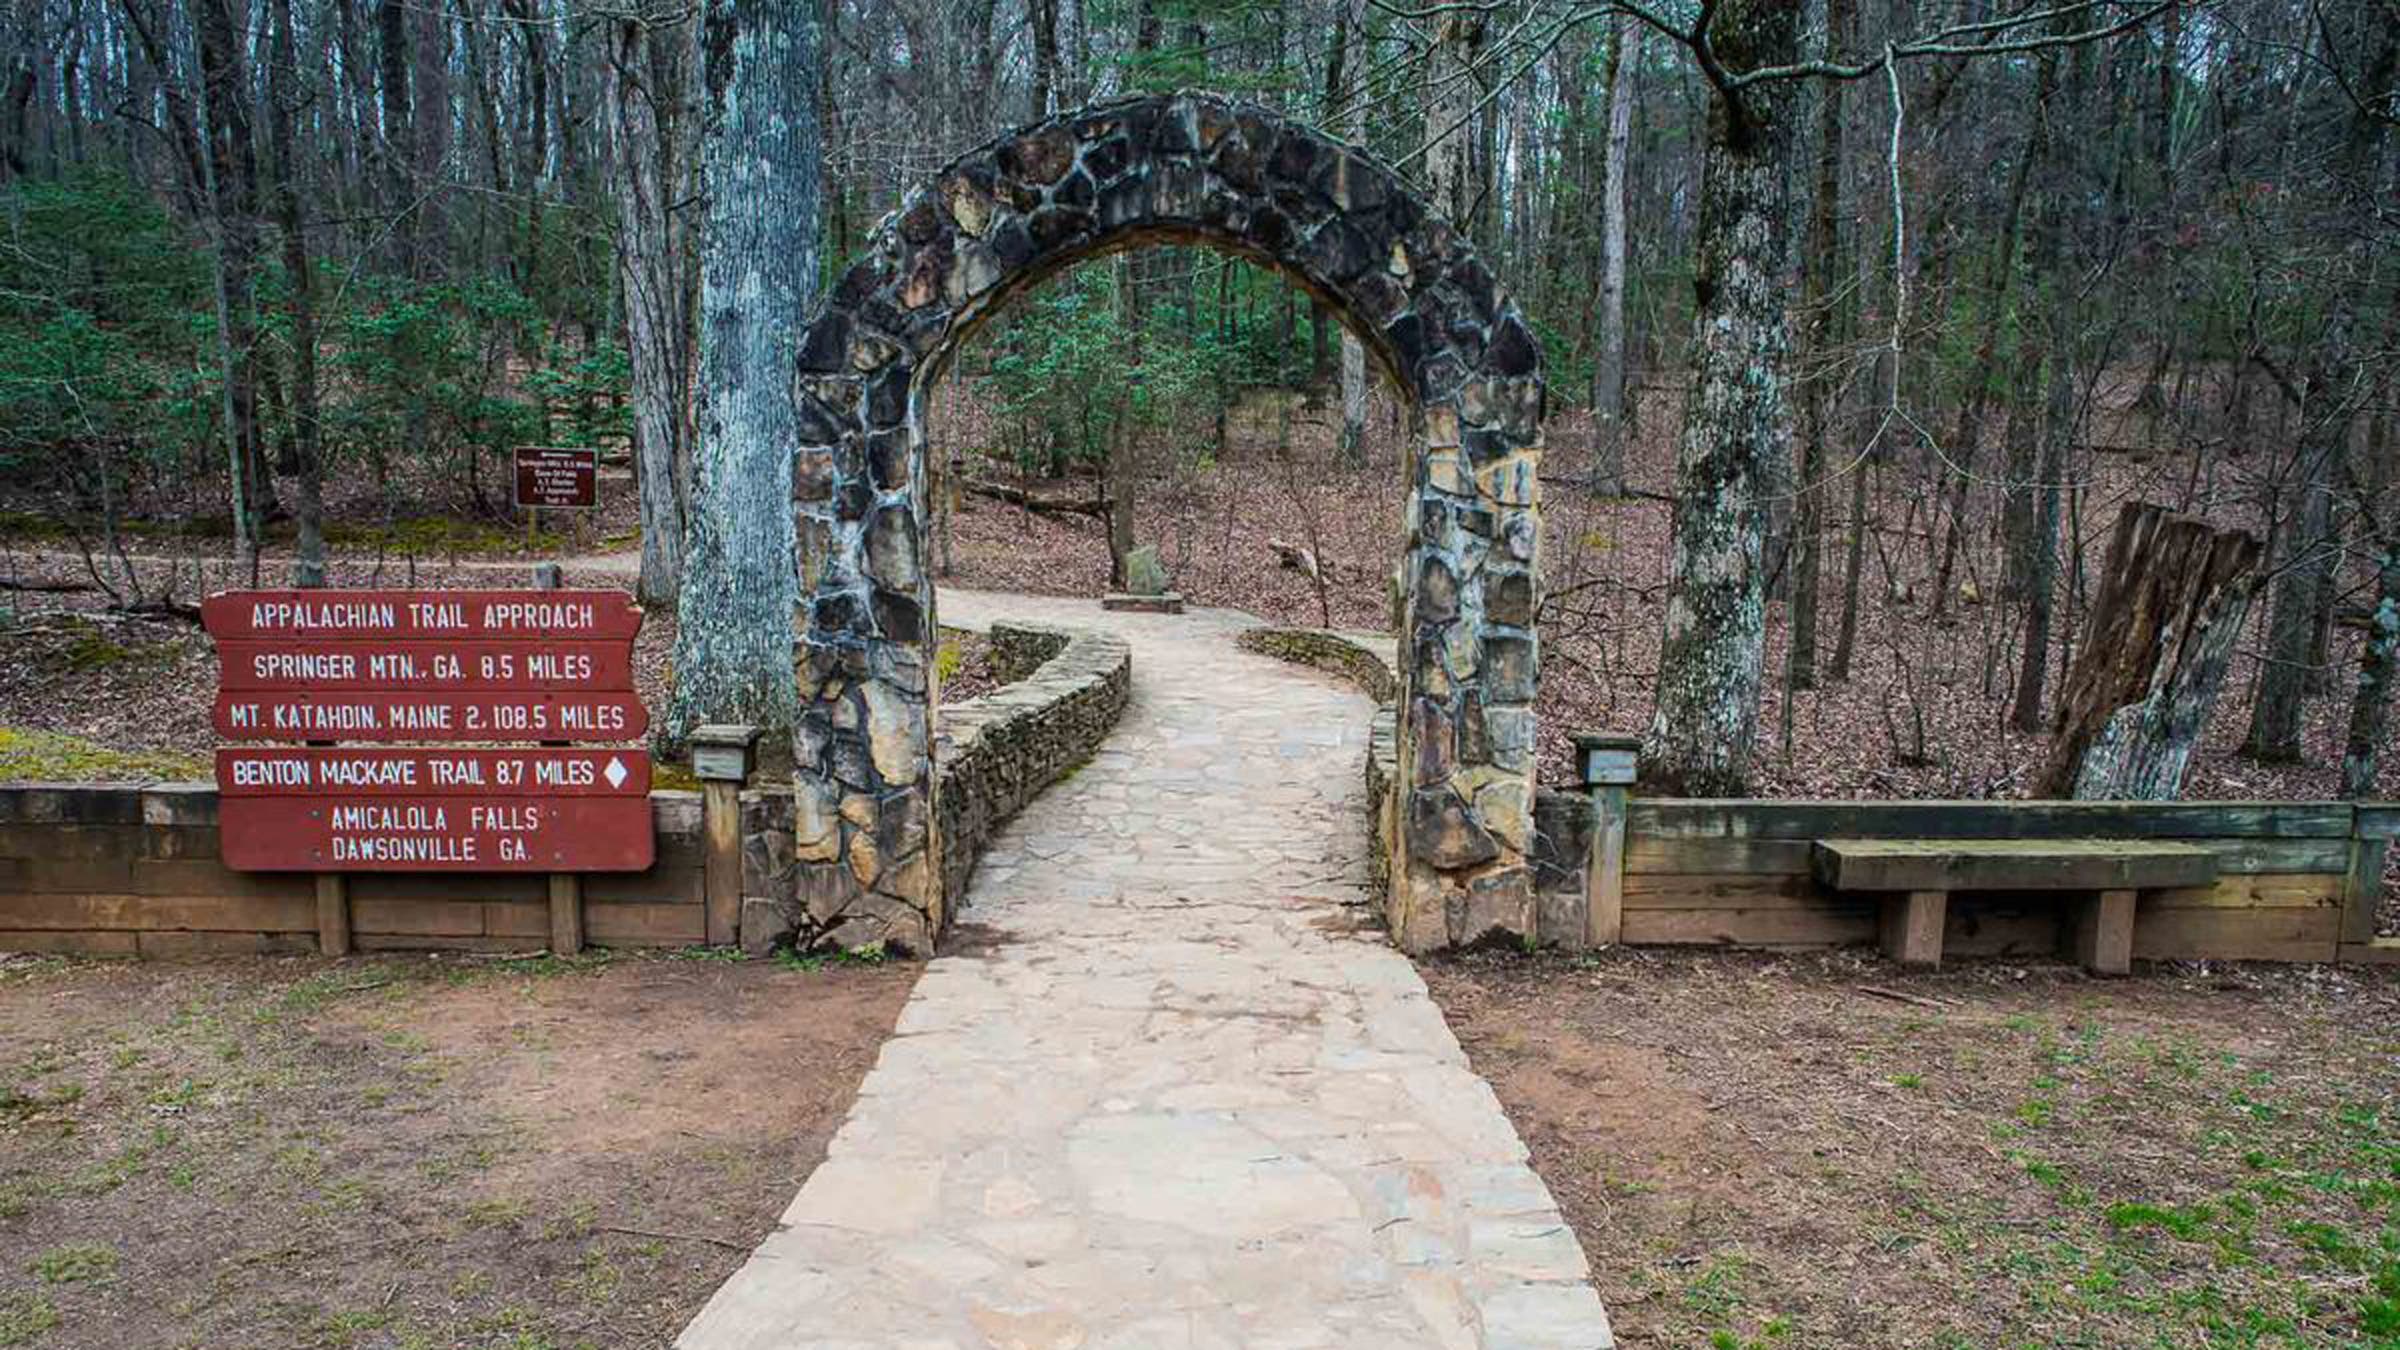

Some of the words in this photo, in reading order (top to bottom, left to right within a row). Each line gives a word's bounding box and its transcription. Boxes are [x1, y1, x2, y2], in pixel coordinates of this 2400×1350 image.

[251, 603, 395, 629] APPALACHIAN
[408, 603, 469, 629] TRAIL
[483, 603, 593, 629] APPROACH
[254, 653, 356, 679] SPRINGER
[434, 654, 467, 679] GA.
[481, 654, 514, 679] 8.5
[528, 654, 592, 680] MILES
[230, 703, 267, 728] MT.
[273, 704, 383, 729] KATAHDIN,
[389, 704, 452, 729] MAINE
[560, 704, 625, 730] MILES
[233, 759, 311, 786] BENTON
[320, 759, 417, 786] MACKAYE
[428, 758, 486, 786] TRAIL
[496, 759, 524, 785] 8.7
[535, 759, 595, 786] MILES
[331, 806, 447, 831] AMICALOLA
[471, 806, 539, 831] FALLS
[332, 837, 477, 861] DAWSONVILLE
